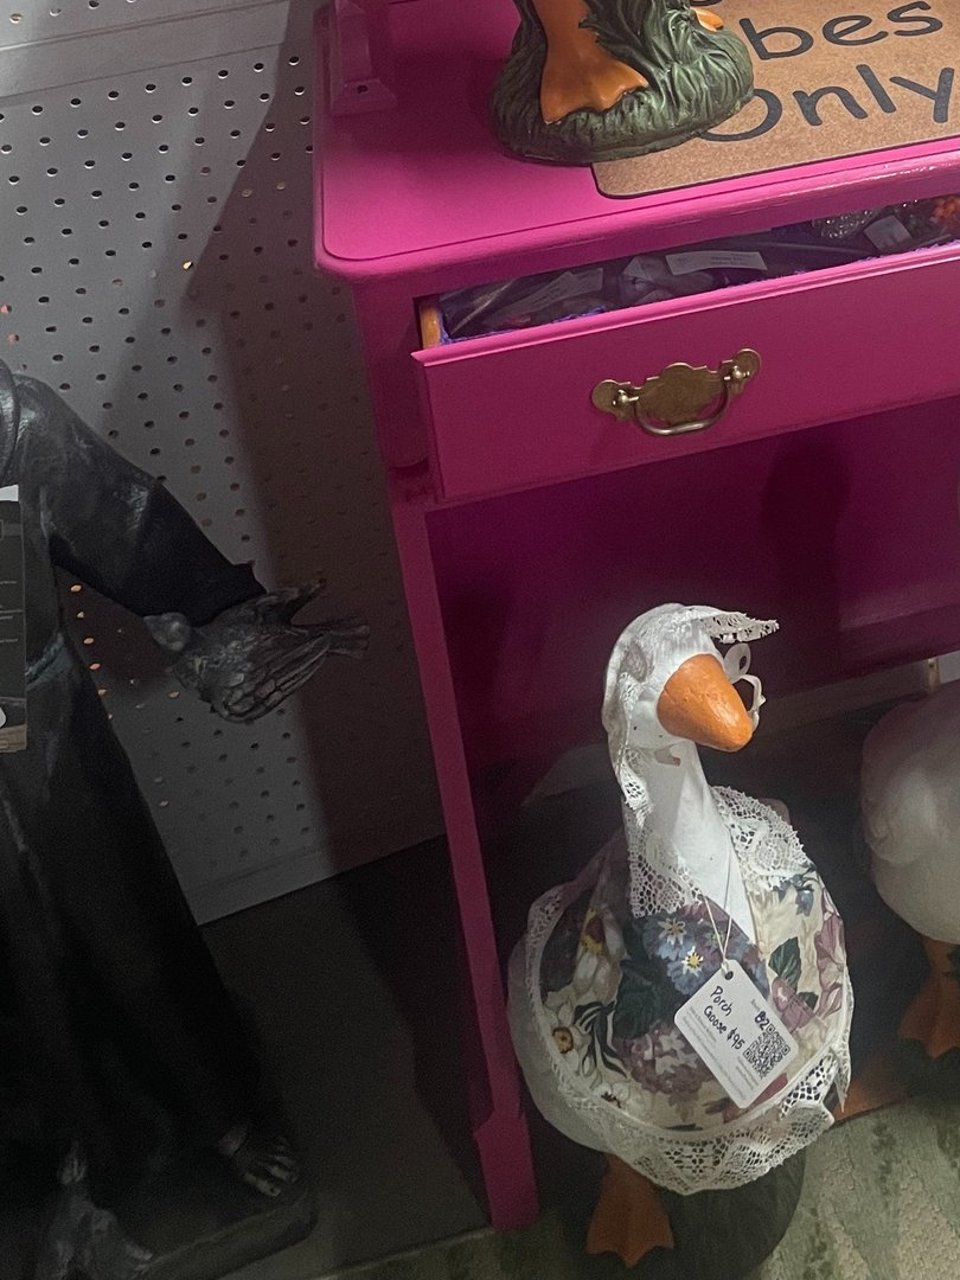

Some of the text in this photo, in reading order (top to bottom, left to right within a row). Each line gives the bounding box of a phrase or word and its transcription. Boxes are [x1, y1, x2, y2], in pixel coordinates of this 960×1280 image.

[738, 0, 944, 61] bes
[709, 985, 733, 1017] Porch
[703, 1005, 727, 1034] Goose
[726, 1027, 746, 1050] $95
